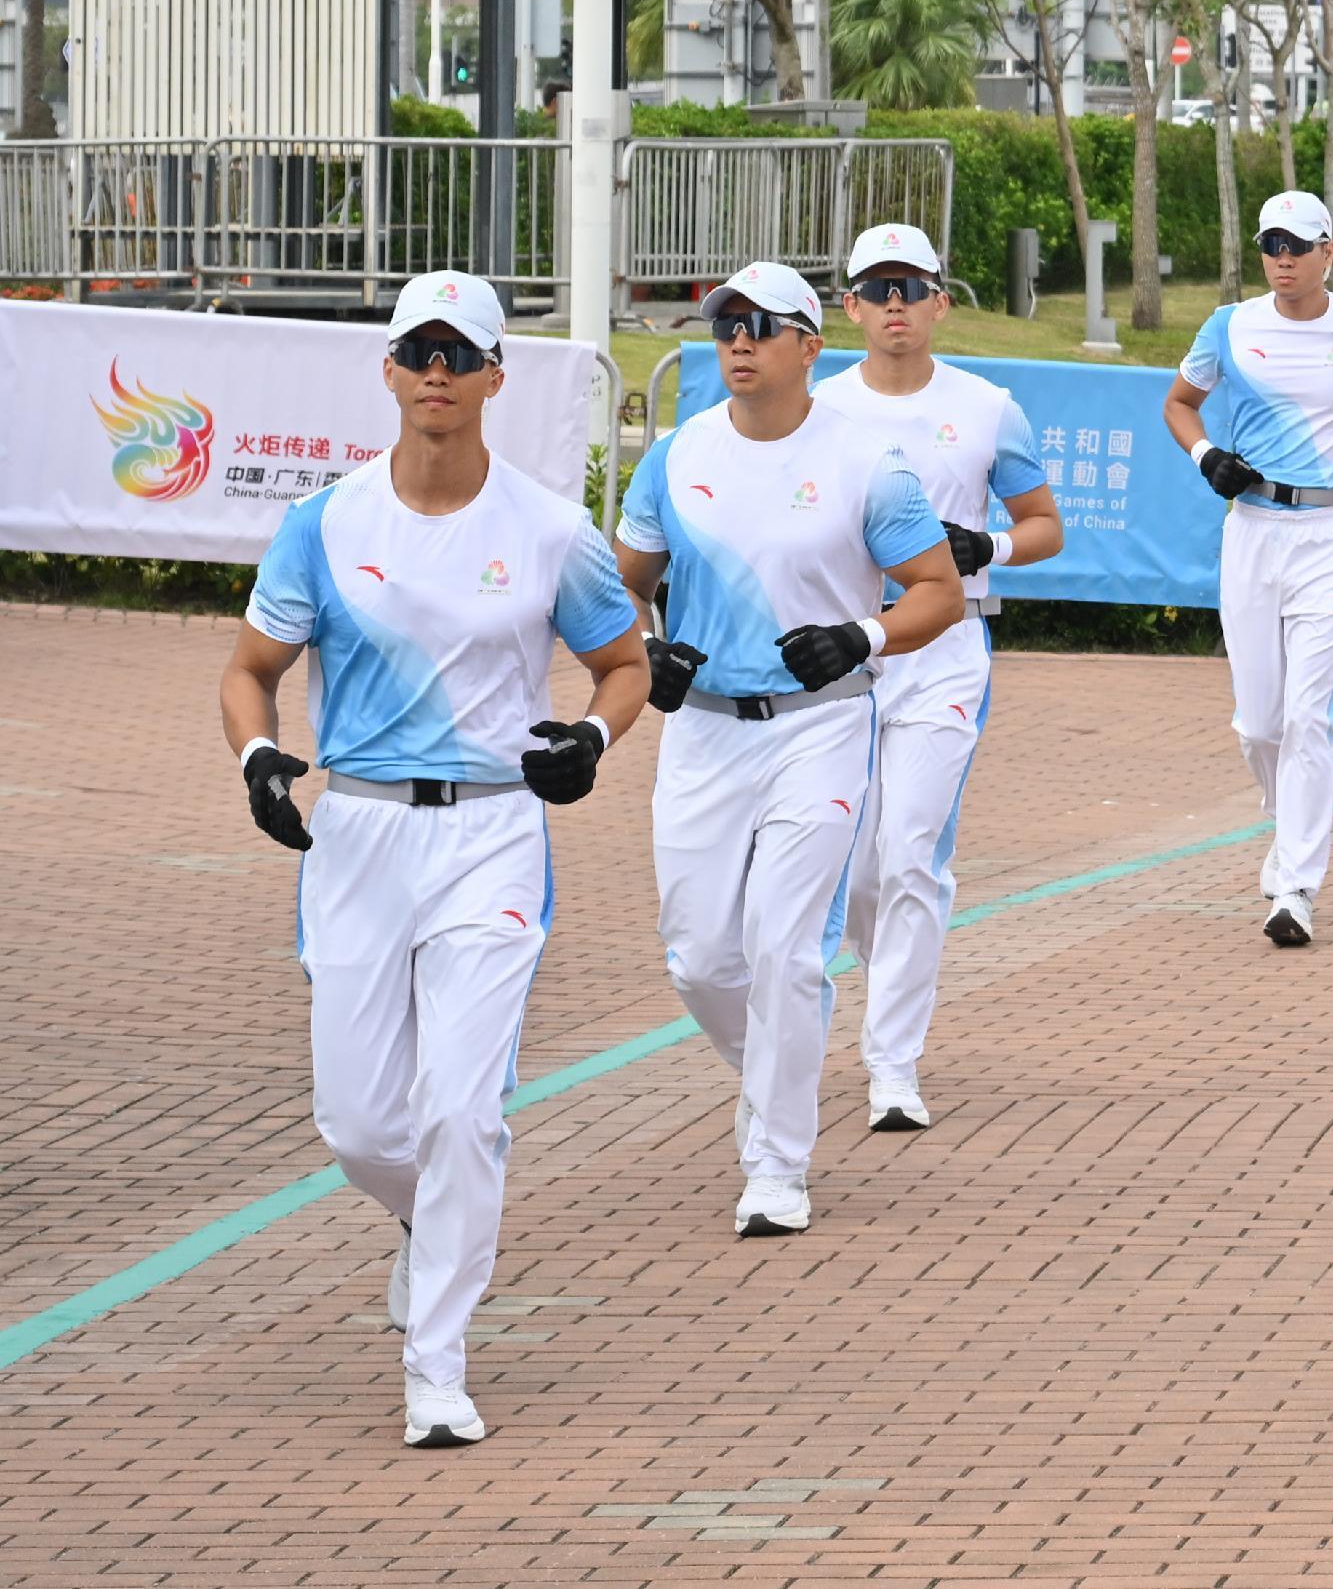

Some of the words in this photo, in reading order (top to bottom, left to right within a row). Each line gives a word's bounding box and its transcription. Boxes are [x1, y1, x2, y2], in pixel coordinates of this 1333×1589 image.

[233, 432, 331, 461] 火炬传递
[1040, 426, 1133, 458] 共和國
[1052, 493, 1105, 510] Games
[1110, 496, 1128, 510] of
[1064, 515, 1080, 528] of
[1083, 515, 1126, 531] China
